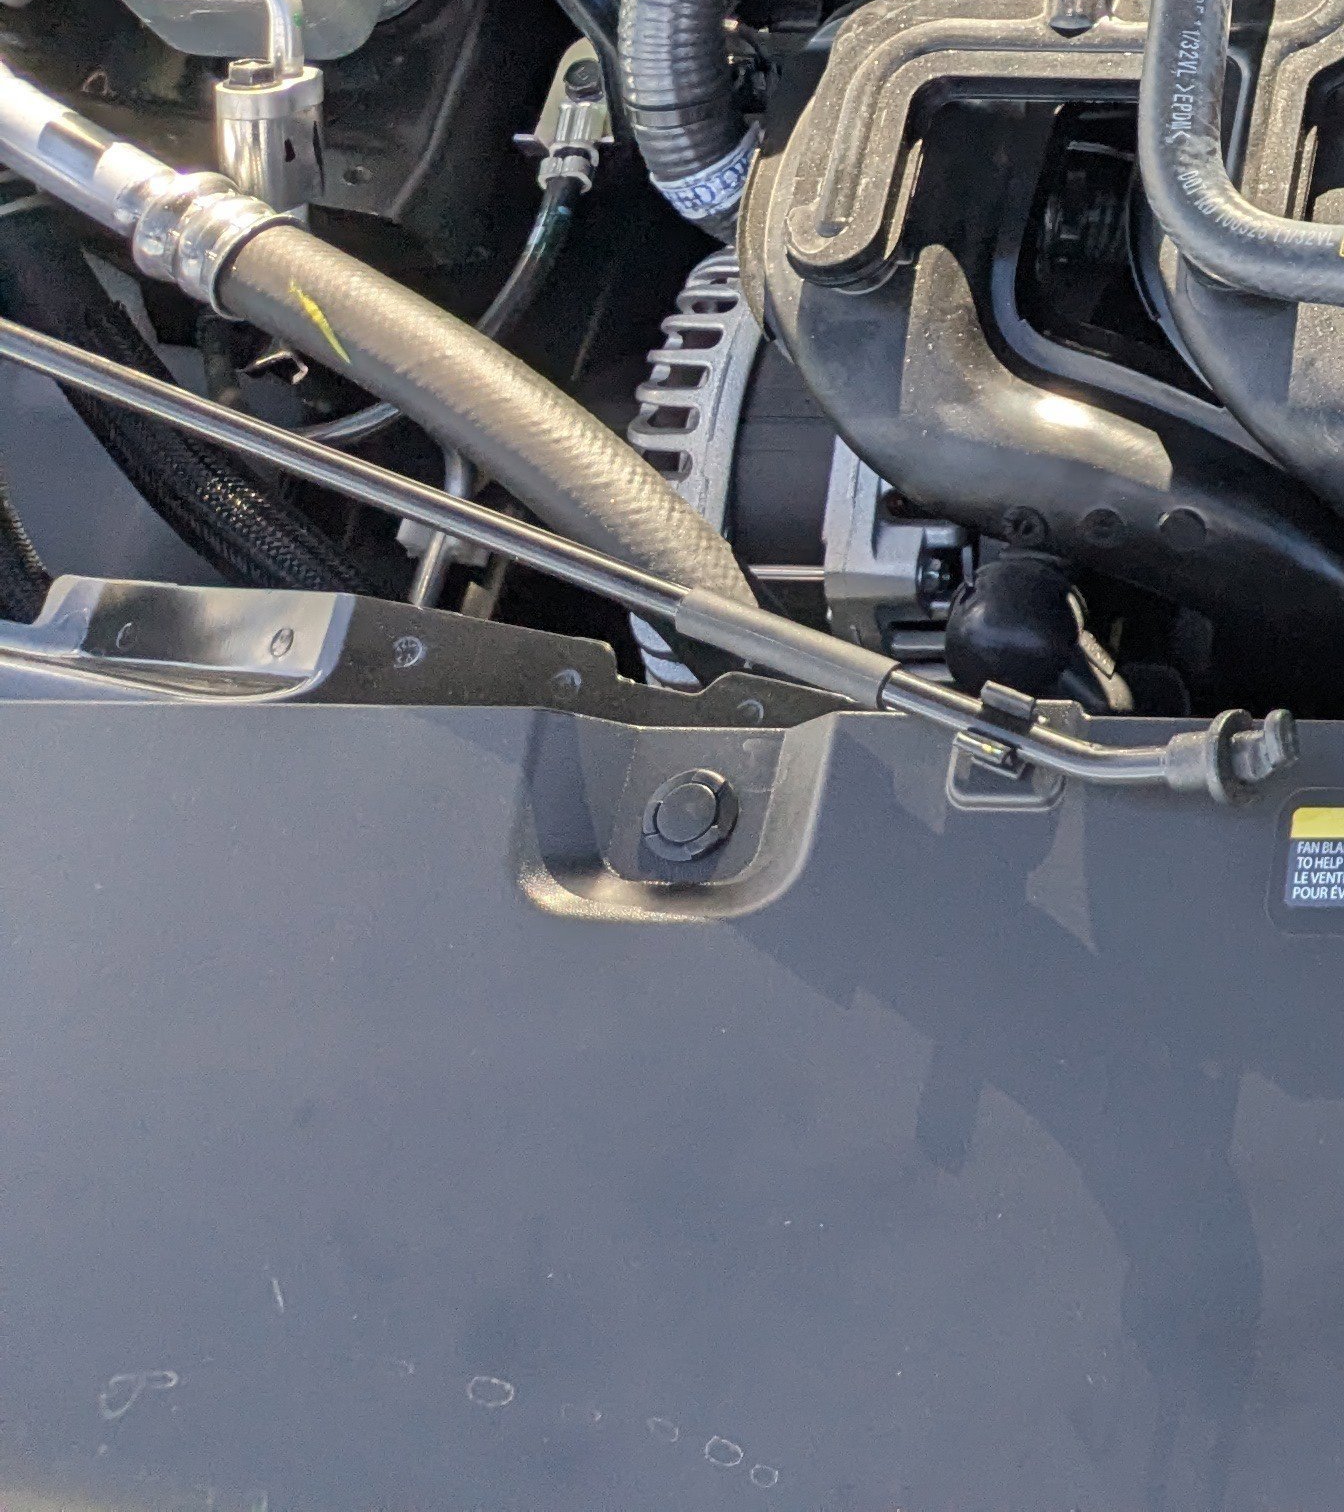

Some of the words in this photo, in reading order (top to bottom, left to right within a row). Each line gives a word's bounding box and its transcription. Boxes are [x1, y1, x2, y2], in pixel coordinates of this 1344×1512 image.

[1297, 841, 1320, 854] FAN
[1298, 857, 1313, 869] TO
[1314, 857, 1344, 869] HELP
[1295, 871, 1309, 885] LE
[1293, 887, 1328, 900] POUR
